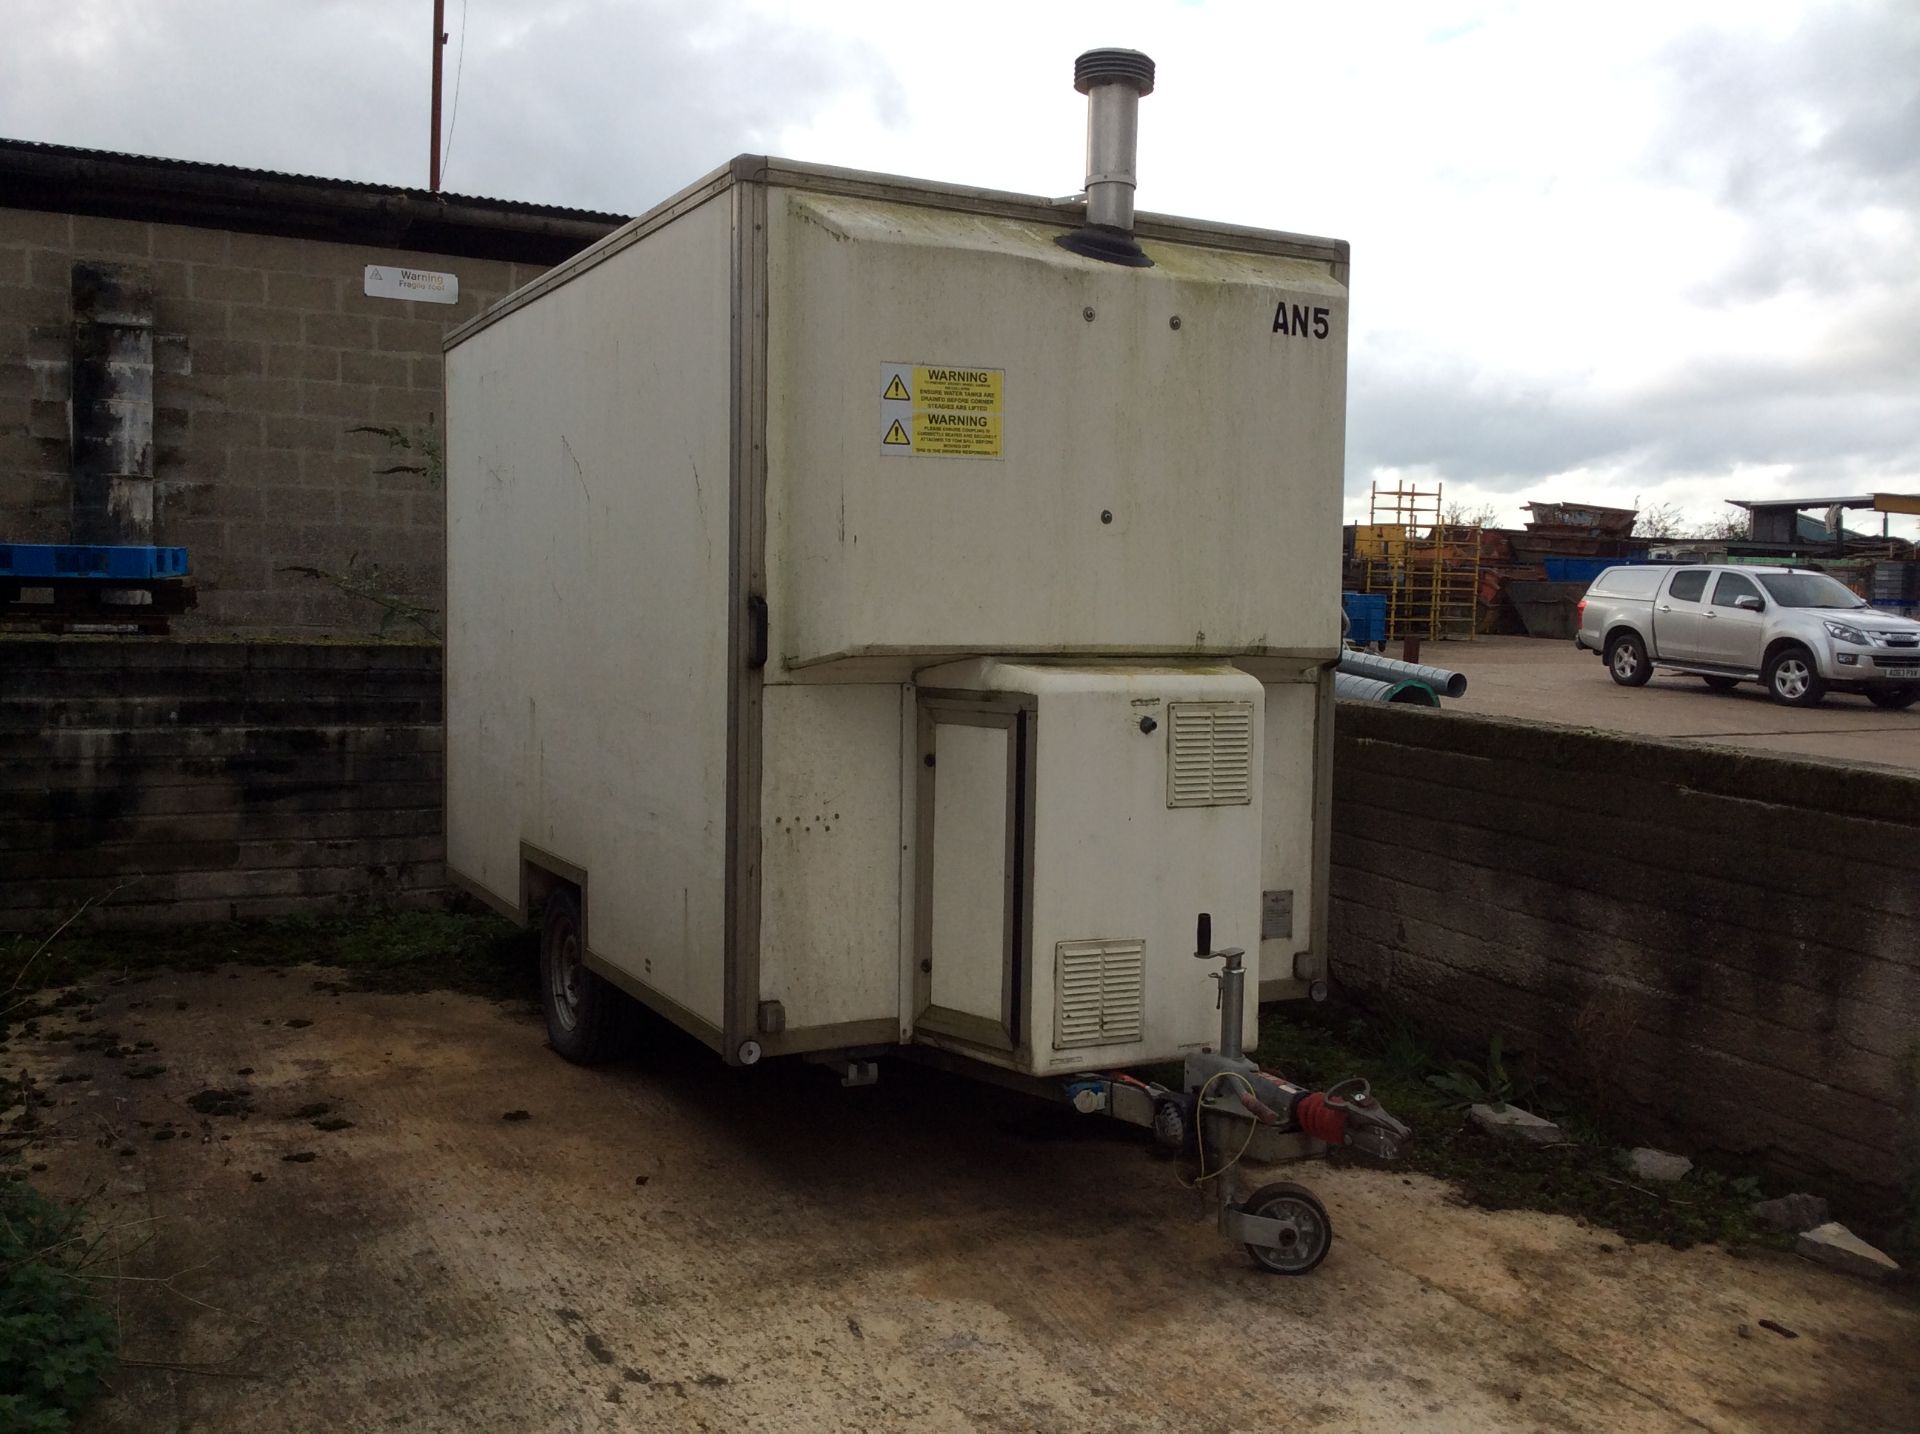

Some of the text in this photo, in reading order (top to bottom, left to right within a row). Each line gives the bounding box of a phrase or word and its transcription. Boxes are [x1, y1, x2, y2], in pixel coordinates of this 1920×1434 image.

[401, 270, 443, 284] Warning
[1272, 301, 1330, 339] AN5
[928, 370, 987, 383] WARNING
[928, 414, 987, 427] WARNING
